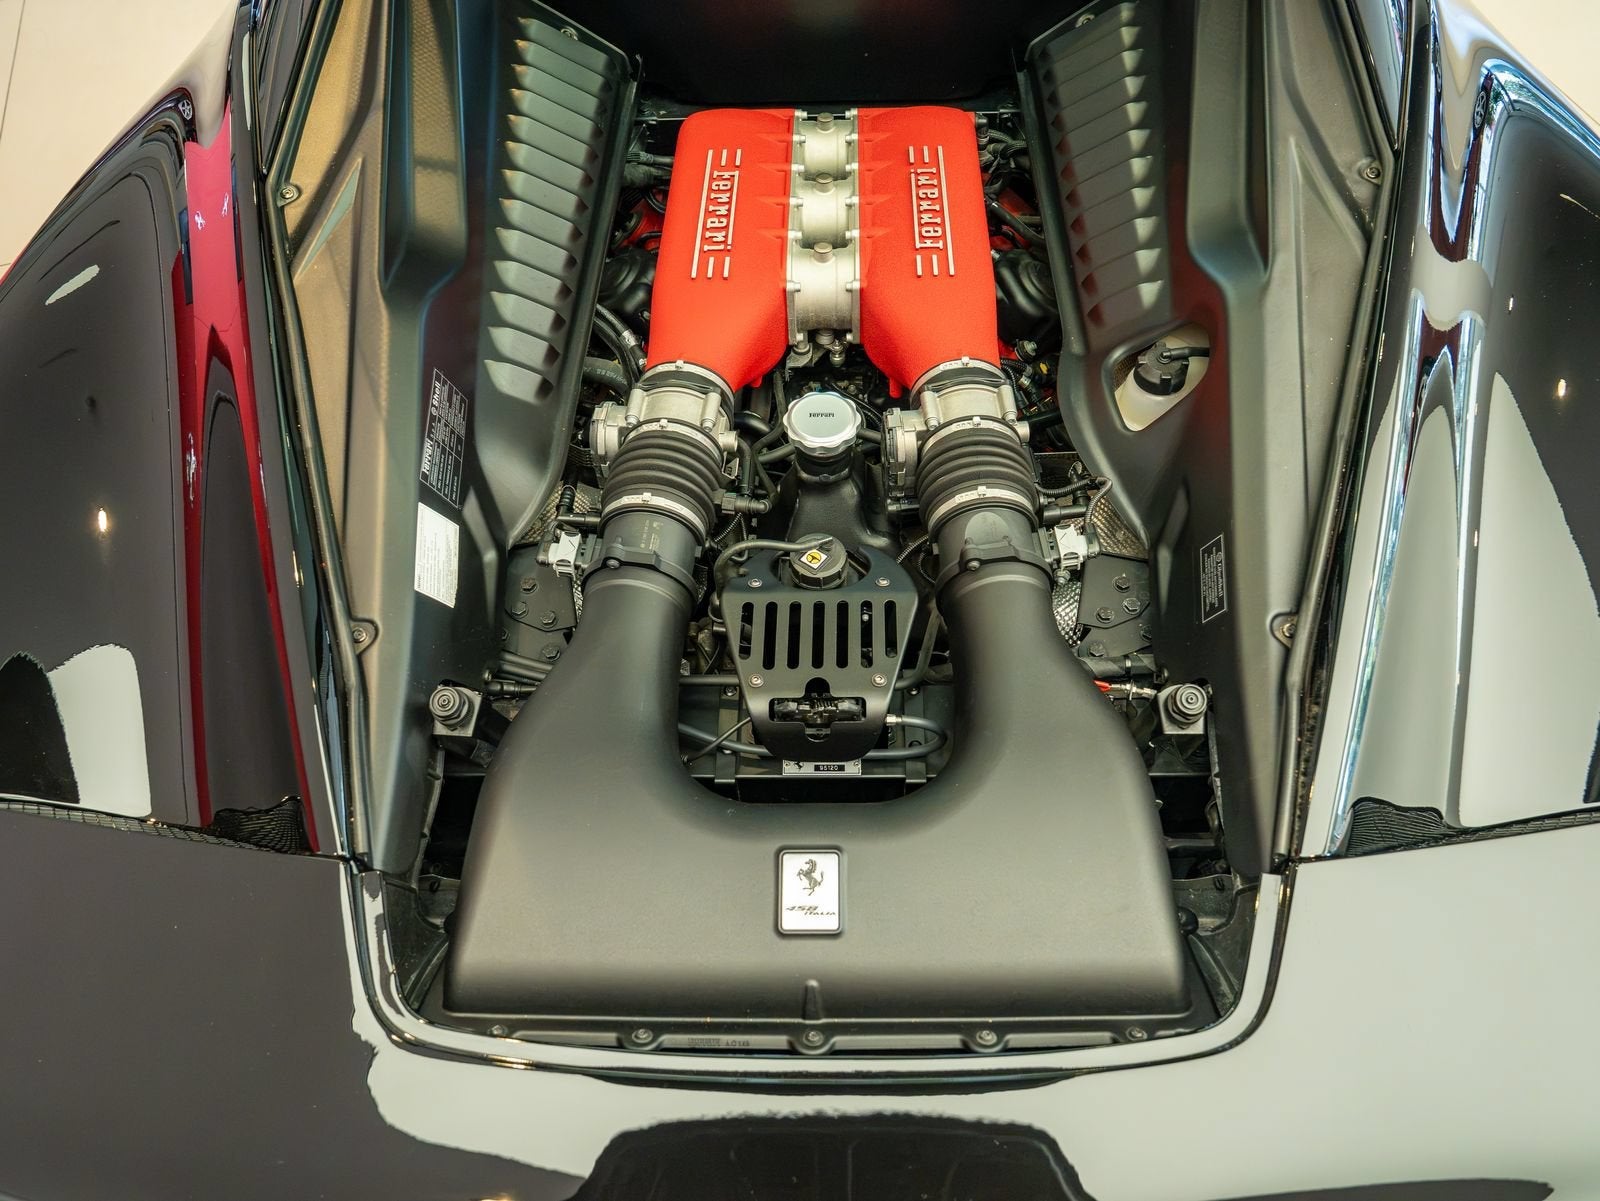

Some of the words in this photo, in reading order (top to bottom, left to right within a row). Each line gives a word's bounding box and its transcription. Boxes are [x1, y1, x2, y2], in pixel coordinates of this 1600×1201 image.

[703, 170, 739, 252] Ferrari
[910, 167, 943, 249] Ferrari
[432, 380, 441, 407] Shell
[421, 437, 433, 475] Ferrari
